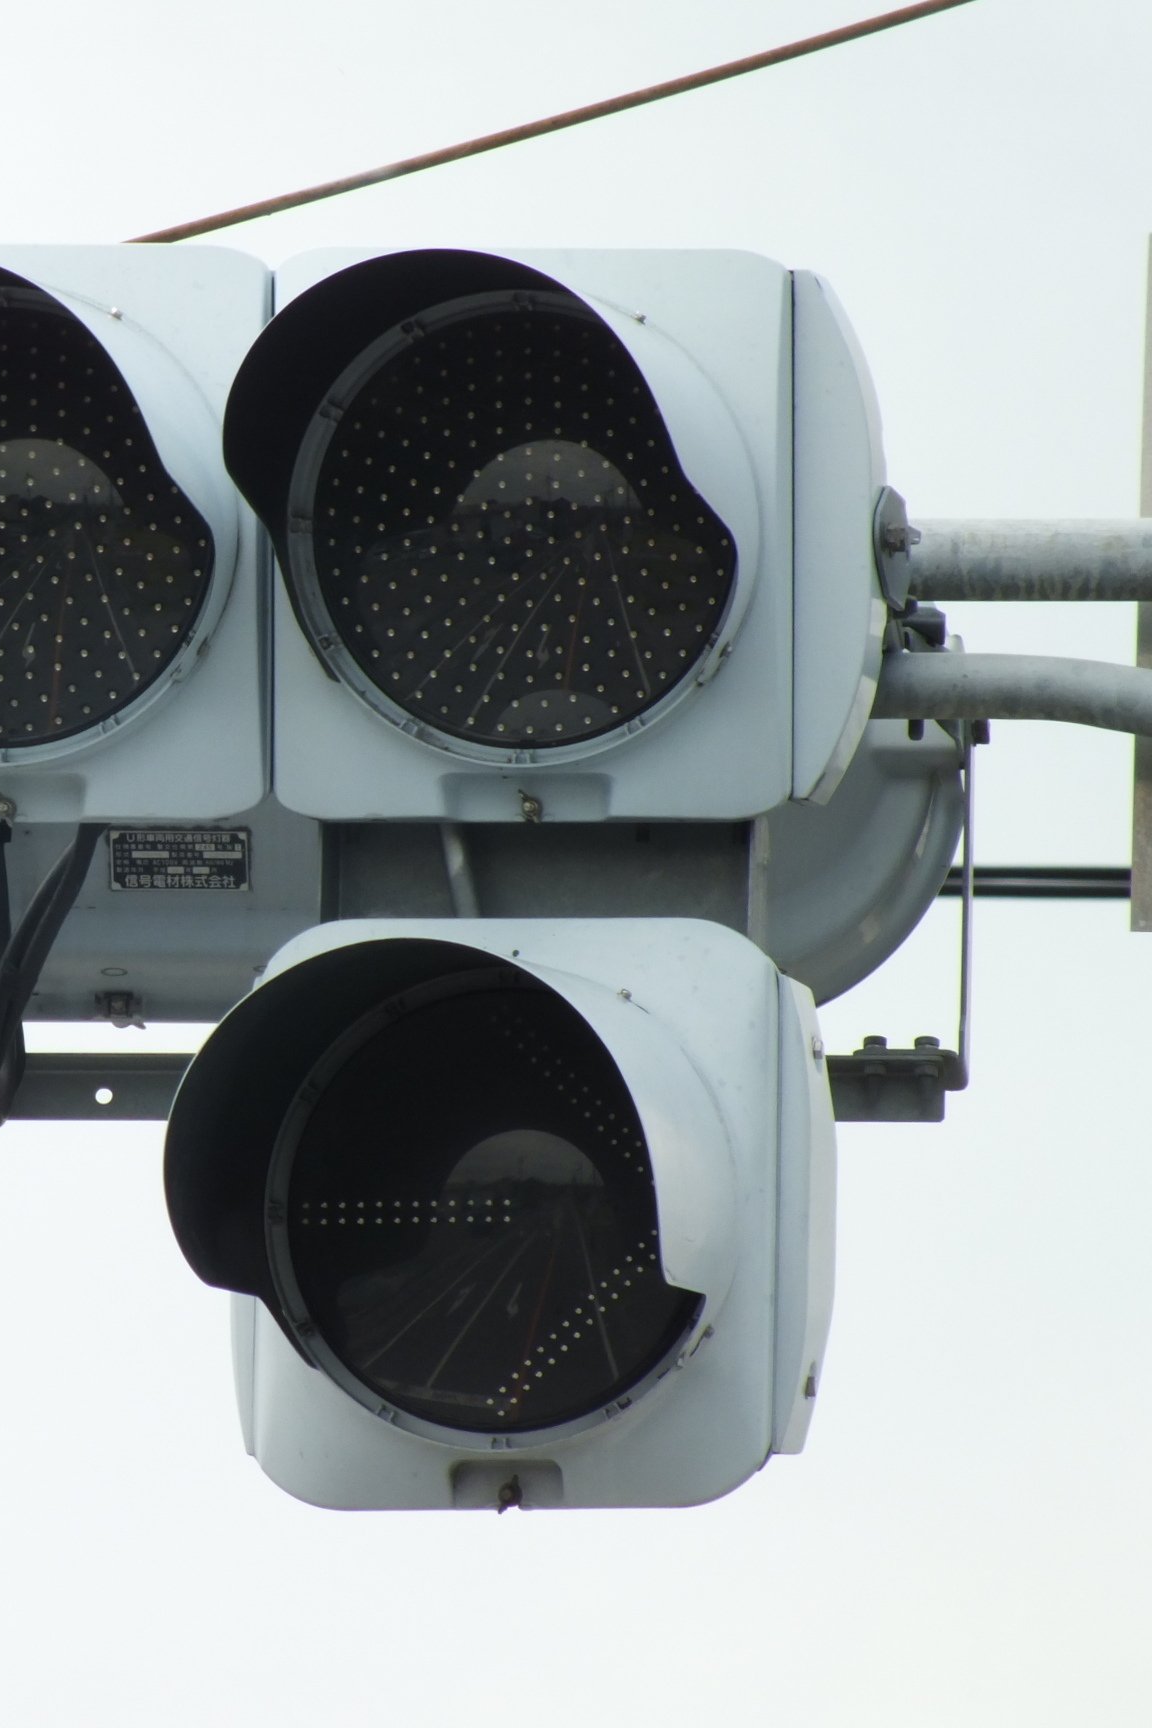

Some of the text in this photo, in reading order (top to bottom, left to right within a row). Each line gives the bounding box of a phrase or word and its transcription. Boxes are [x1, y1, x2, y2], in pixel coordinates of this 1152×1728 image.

[125, 874, 237, 889] 信号電材株式会社
